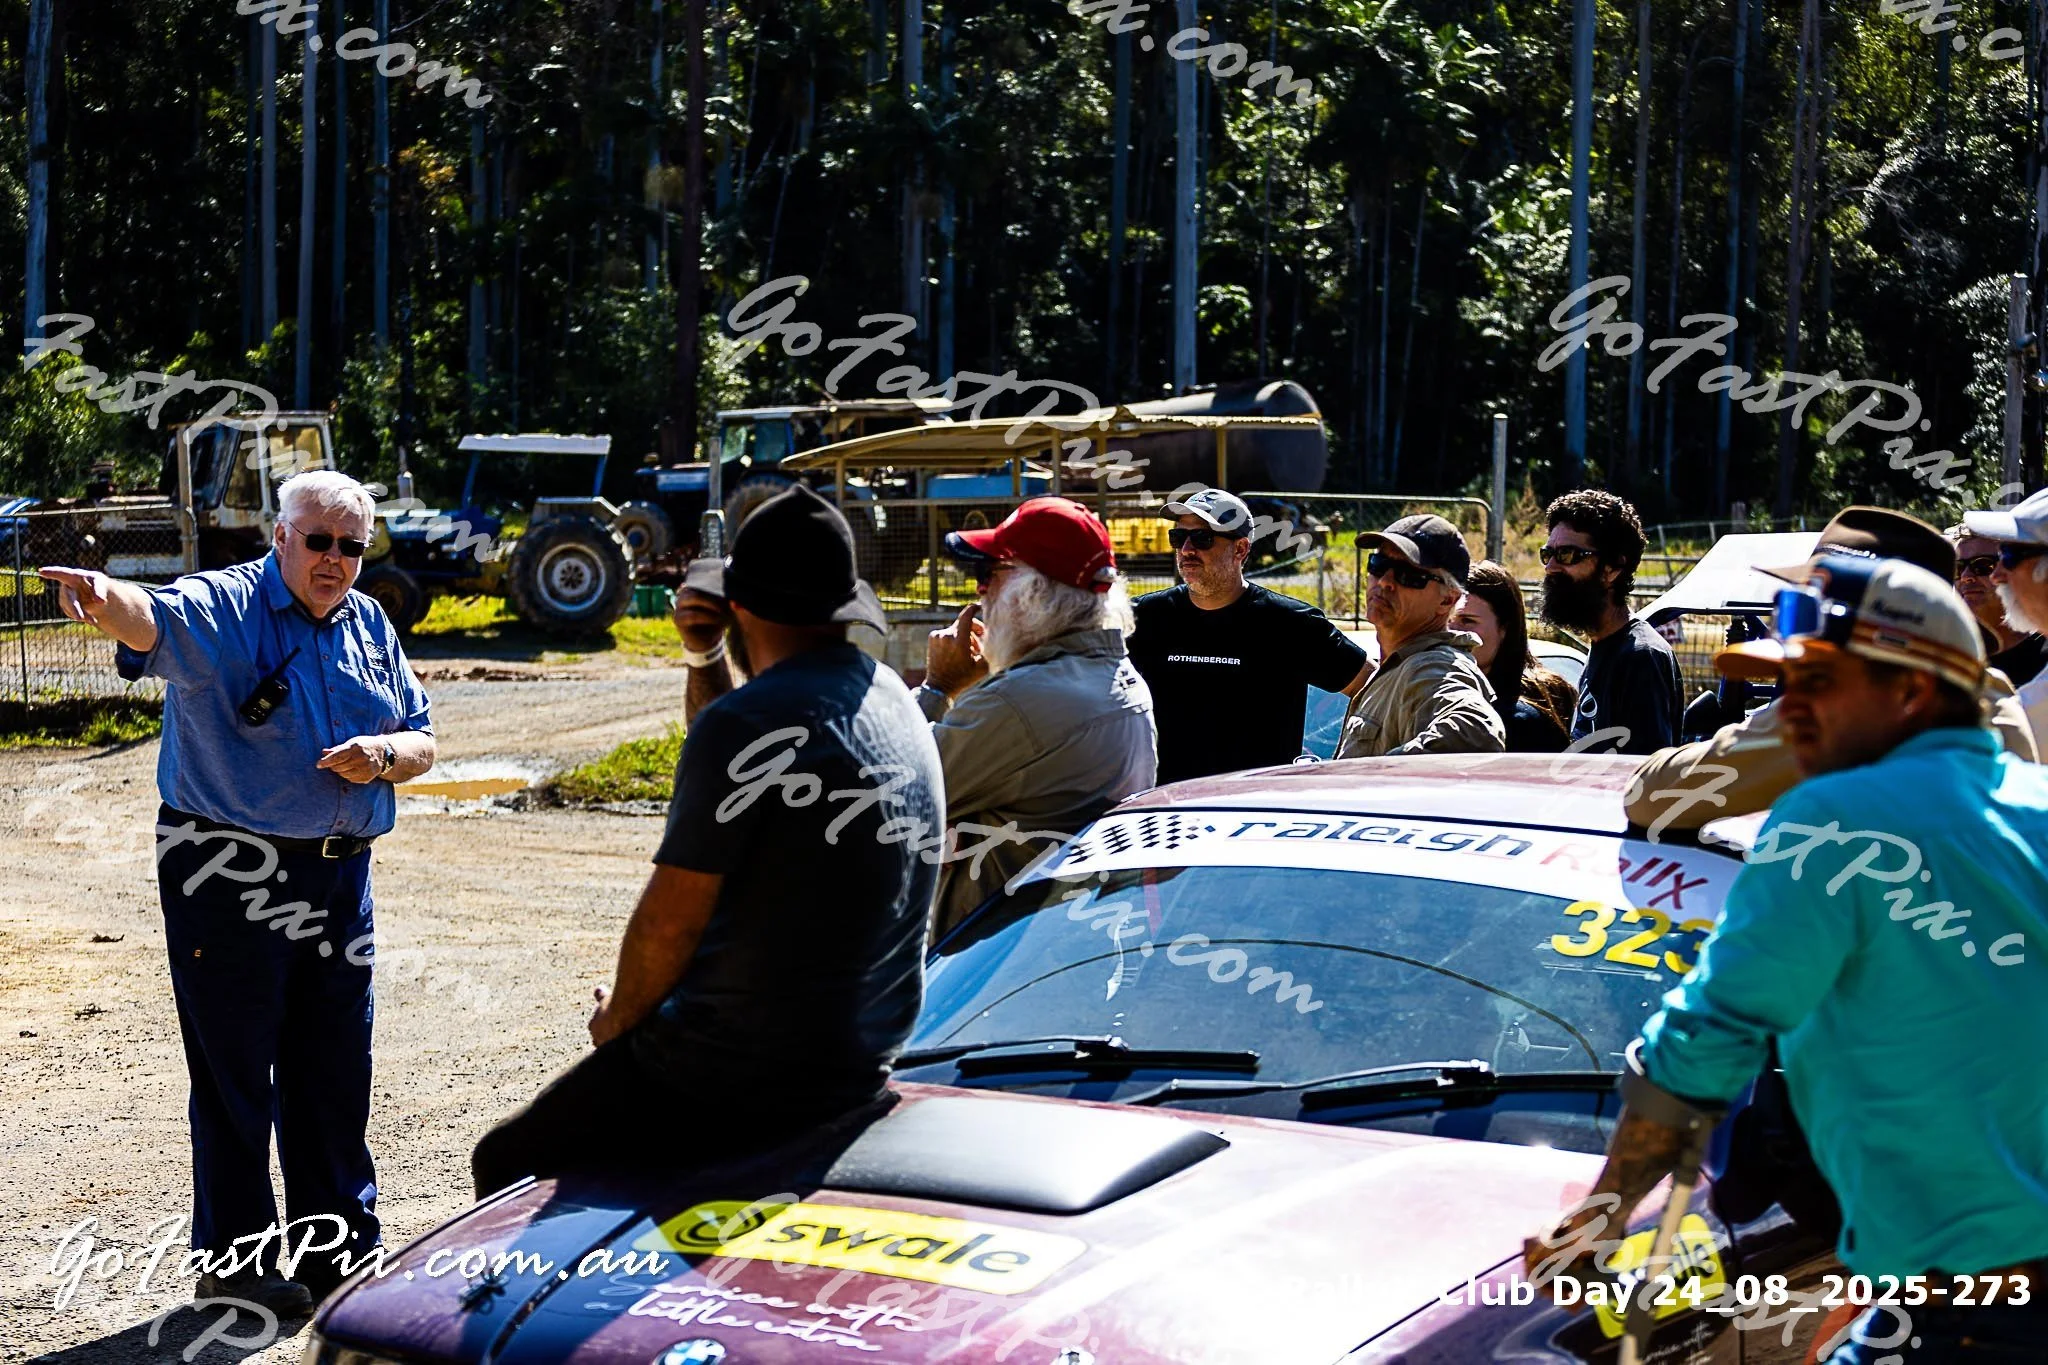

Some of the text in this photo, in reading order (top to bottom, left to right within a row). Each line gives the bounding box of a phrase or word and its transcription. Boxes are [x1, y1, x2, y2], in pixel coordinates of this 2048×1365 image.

[1167, 654, 1241, 666] ROTHENBERGER
[1228, 820, 1534, 857] raleigh
[764, 1221, 1032, 1275] swale
